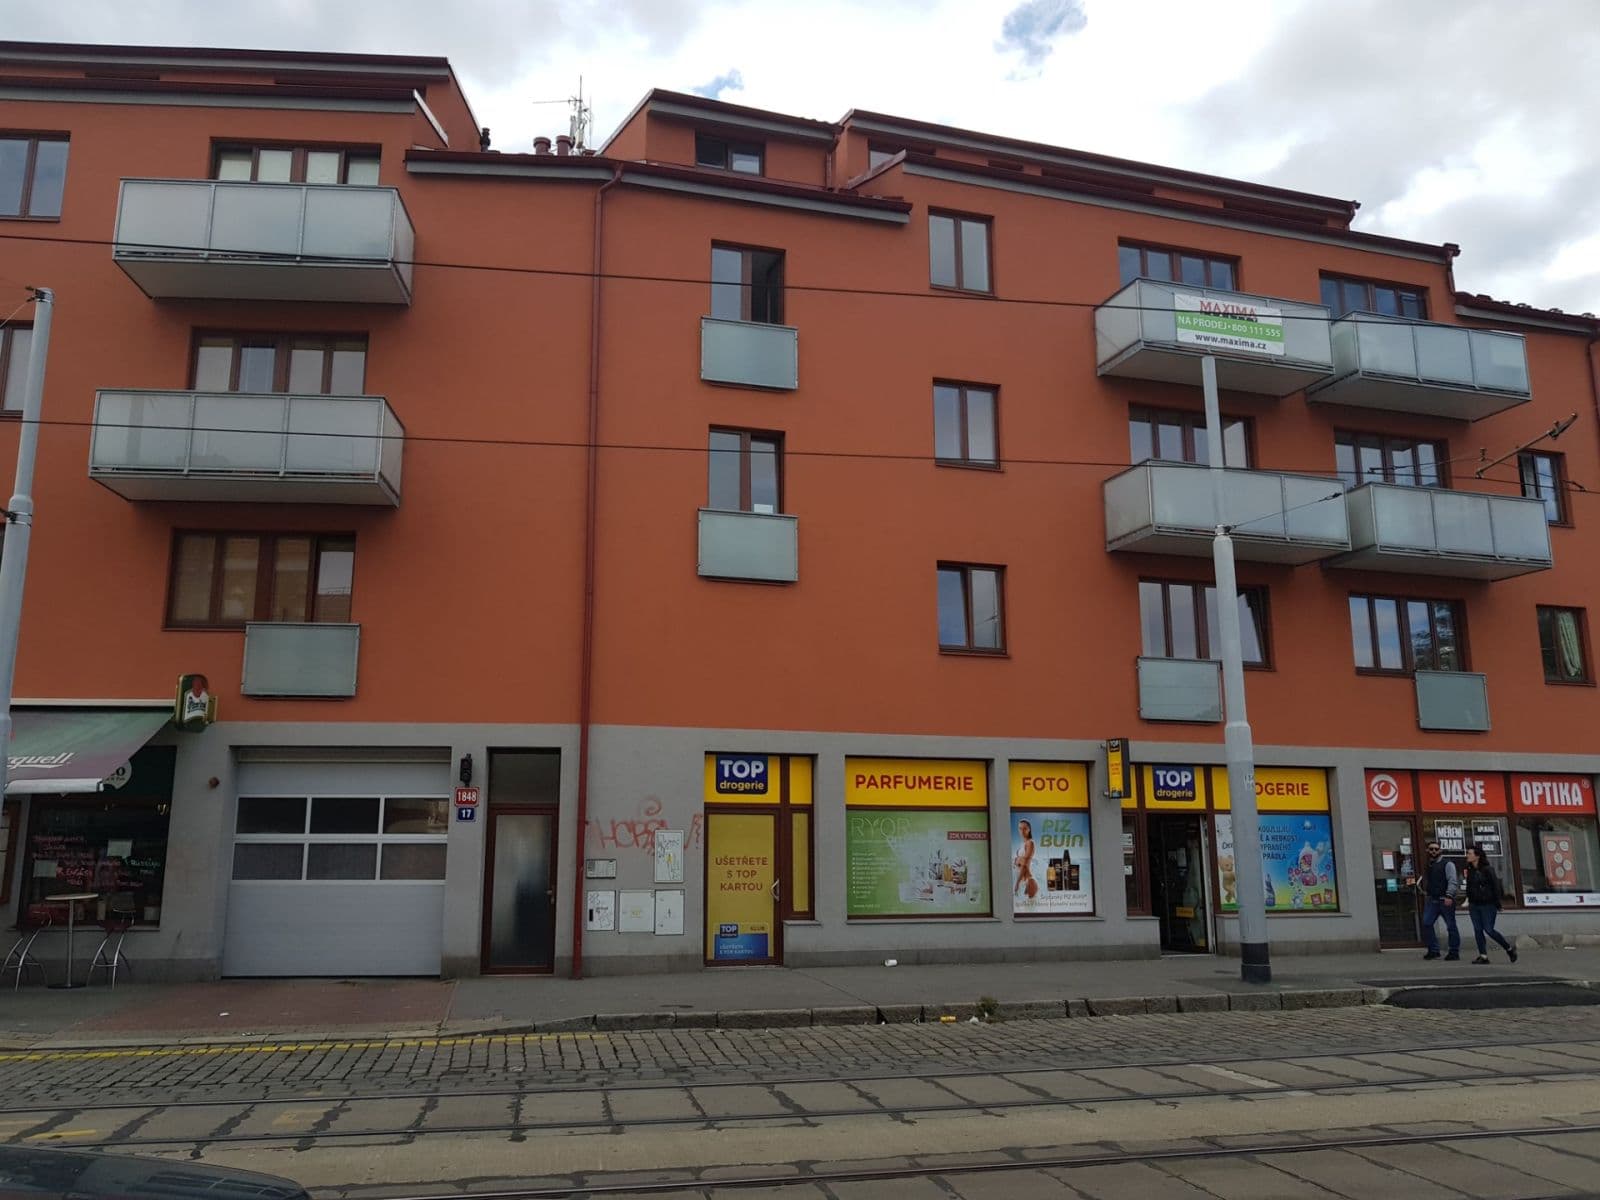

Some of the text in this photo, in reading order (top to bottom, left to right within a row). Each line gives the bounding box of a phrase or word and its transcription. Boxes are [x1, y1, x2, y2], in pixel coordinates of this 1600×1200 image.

[1200, 300, 1257, 317] MAXIMA
[1178, 316, 1191, 325] NA
[1193, 318, 1227, 330] PRODEJ
[1231, 324, 1248, 333] 800
[1249, 326, 1264, 336] 111
[1265, 328, 1281, 338] 555
[1195, 333, 1267, 350] www.maxima.cz
[720, 759, 765, 778] TOP
[855, 774, 973, 791] PARFUMERIE
[1021, 777, 1070, 792] FOTO
[1155, 770, 1192, 787] TOP
[719, 779, 764, 792] drogerie
[1255, 782, 1311, 796] OGERIE
[1439, 777, 1584, 806] VAŠE OPTIKA
[456, 791, 477, 802] 1848
[1156, 788, 1193, 799] drogerie
[461, 809, 472, 818] 17
[1042, 819, 1072, 832] PIZ
[1440, 838, 1463, 850] ZRAKU
[715, 855, 768, 867] UŠETŘETE
[726, 869, 757, 879] S TOP
[720, 881, 763, 892] KARTOU
[721, 925, 738, 933] TOP
